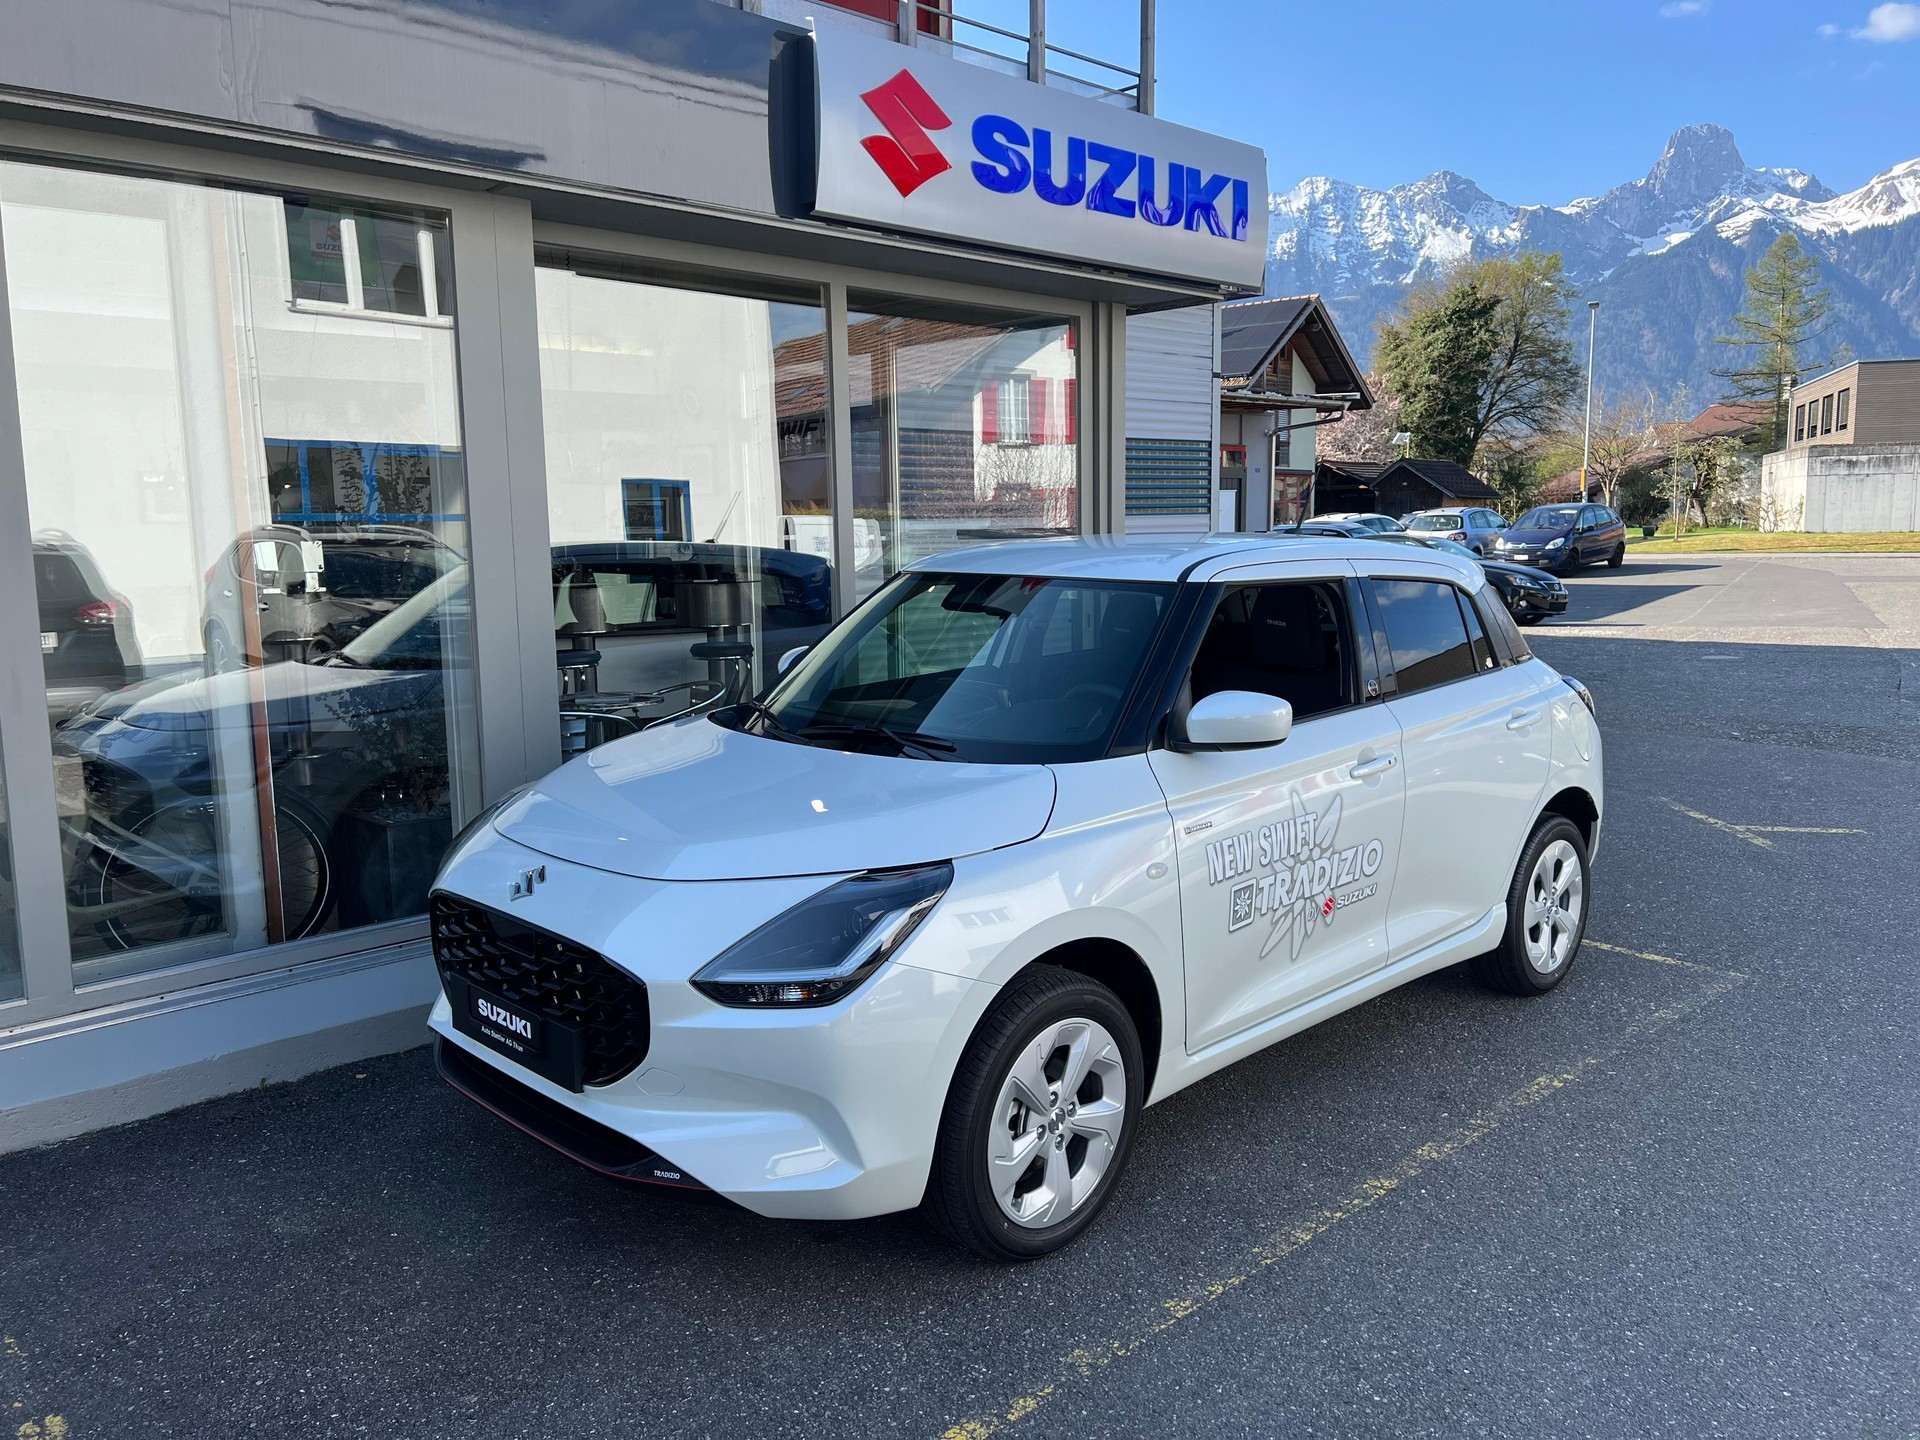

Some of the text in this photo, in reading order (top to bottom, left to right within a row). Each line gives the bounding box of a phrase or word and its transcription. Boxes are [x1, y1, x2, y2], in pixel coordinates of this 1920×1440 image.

[970, 114, 1249, 241] SUZUKI
[315, 242, 343, 252] SUZU
[1206, 812, 1317, 885] NEW SWIFT
[1259, 838, 1383, 915] TRADIZIO
[1307, 883, 1378, 922] by SUZUKI
[477, 998, 532, 1039] SUZUKI
[481, 1025, 491, 1036] Auto
[654, 1170, 680, 1179] TRADIZIO
